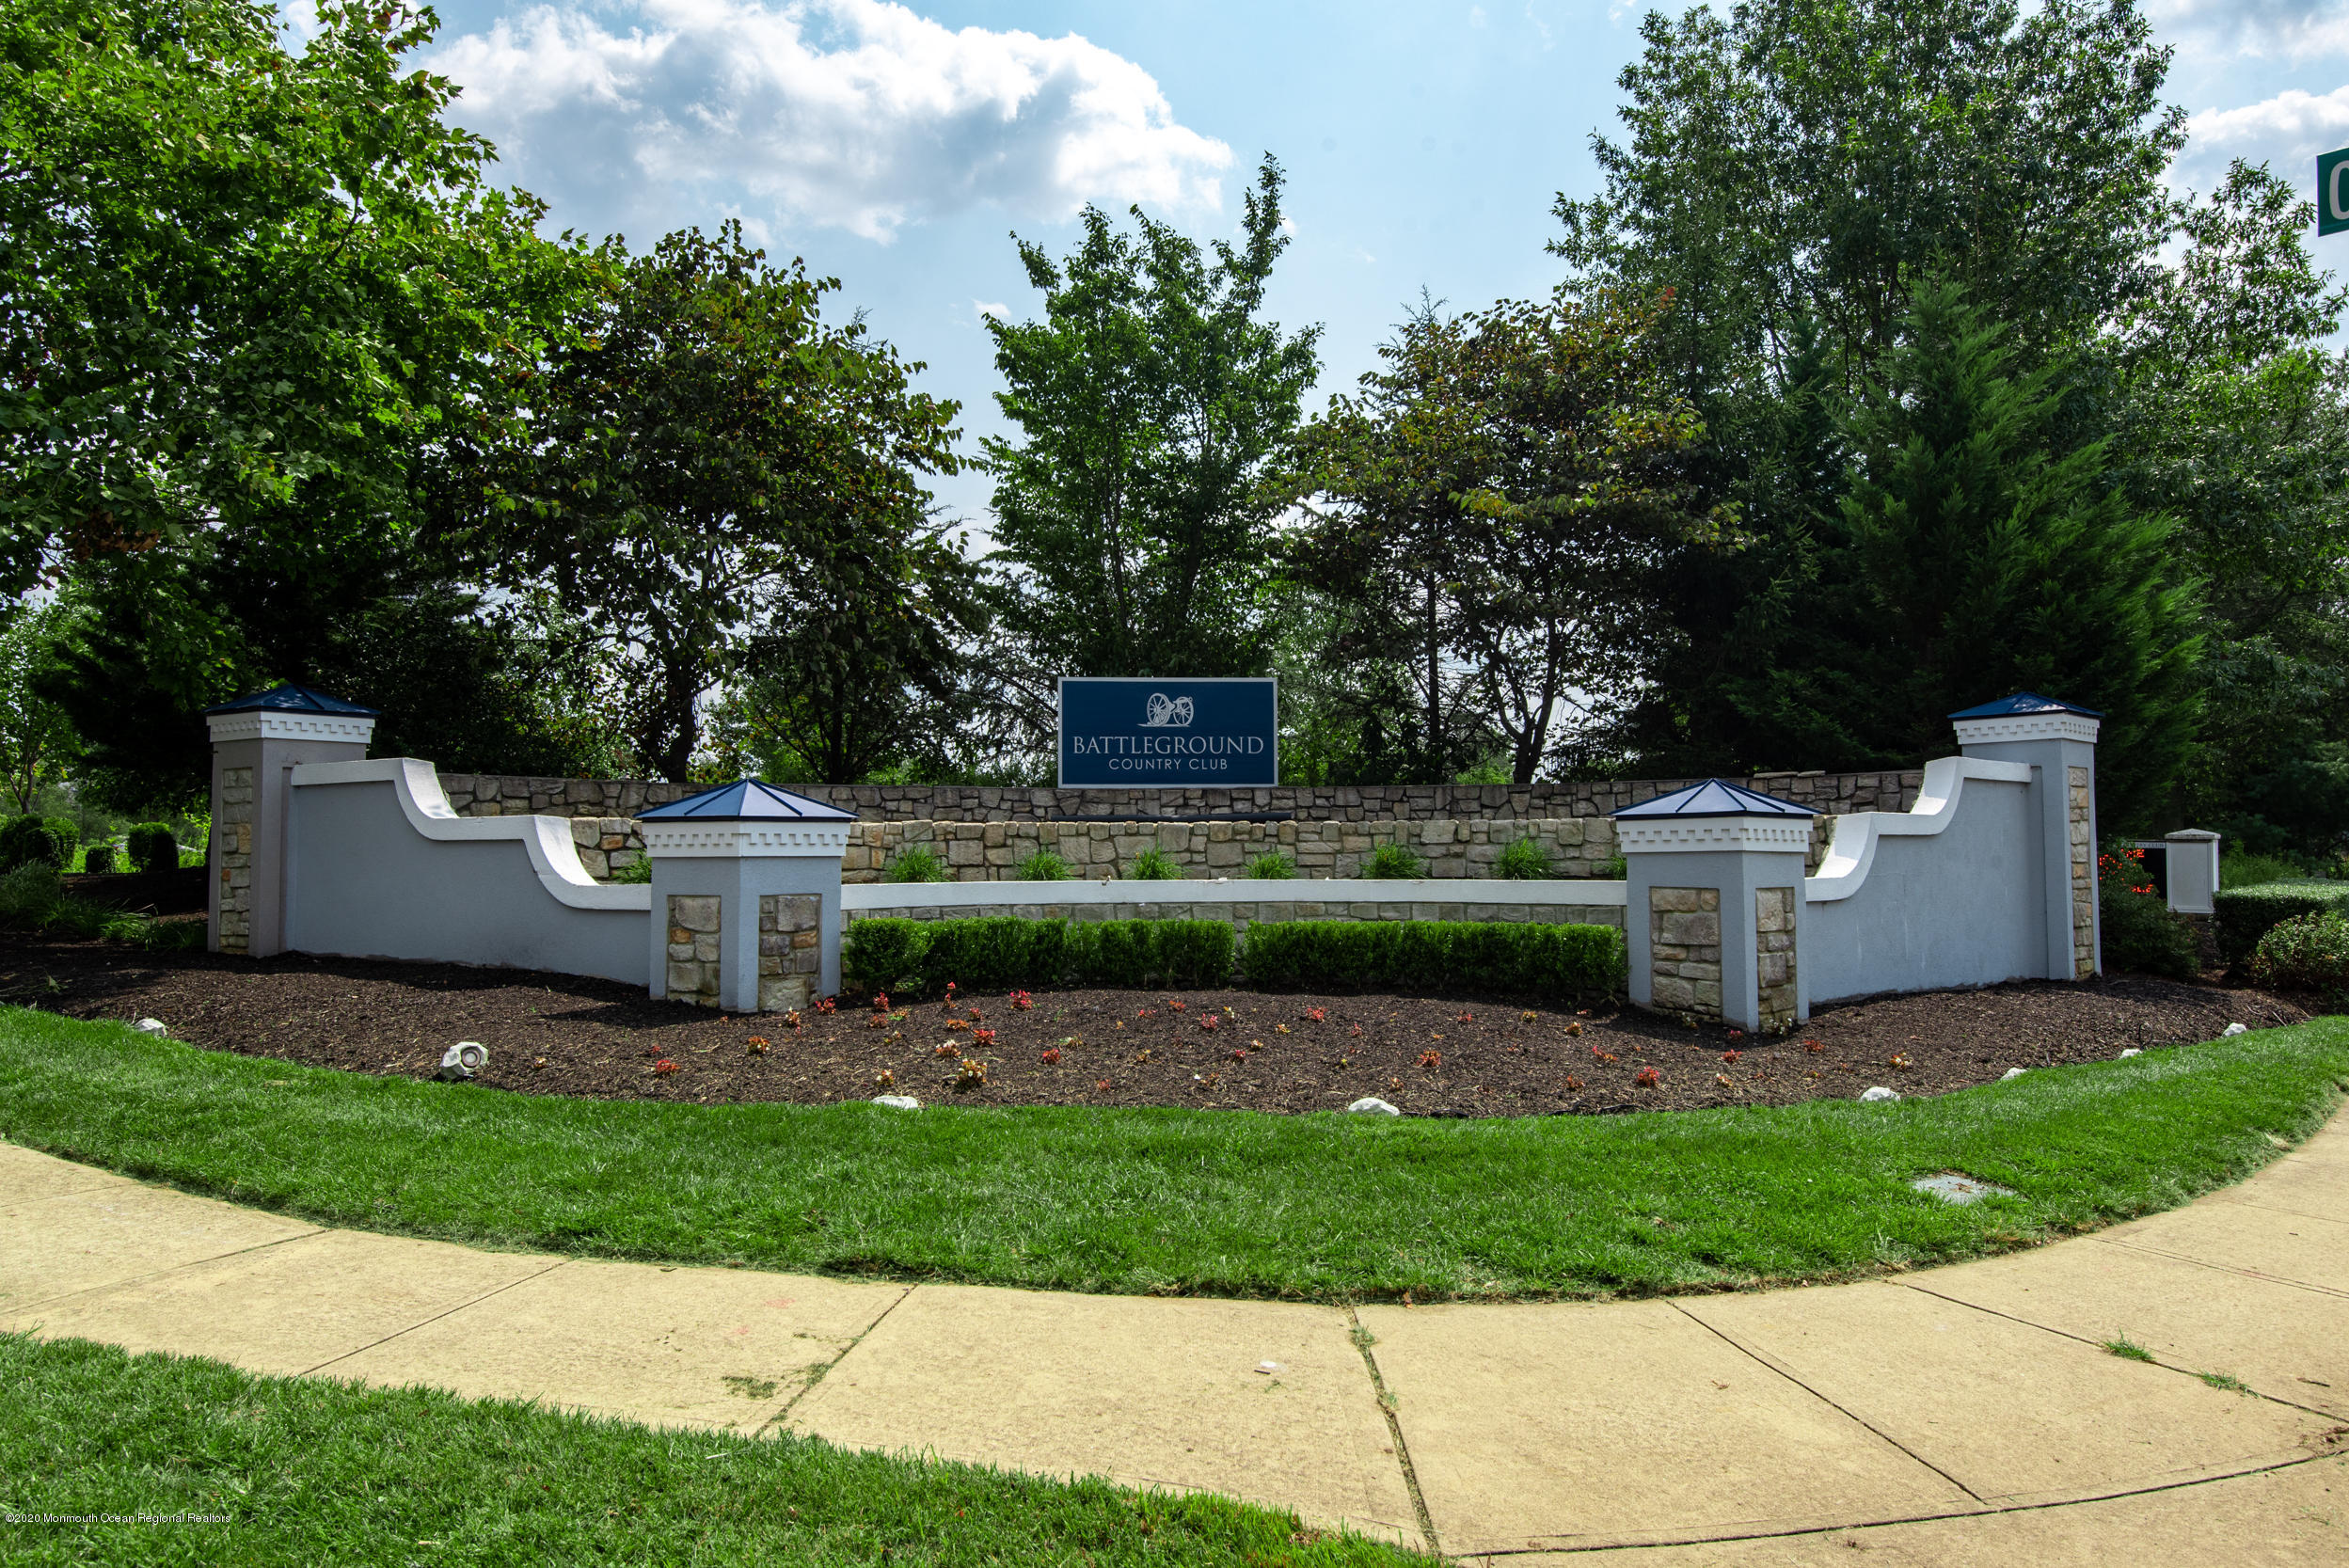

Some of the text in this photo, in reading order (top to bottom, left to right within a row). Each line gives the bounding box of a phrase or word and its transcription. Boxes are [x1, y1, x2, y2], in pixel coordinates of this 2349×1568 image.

[1072, 736, 1264, 754] BATTLEGROUND
[1108, 758, 1228, 770] COUNTRY CLUB
